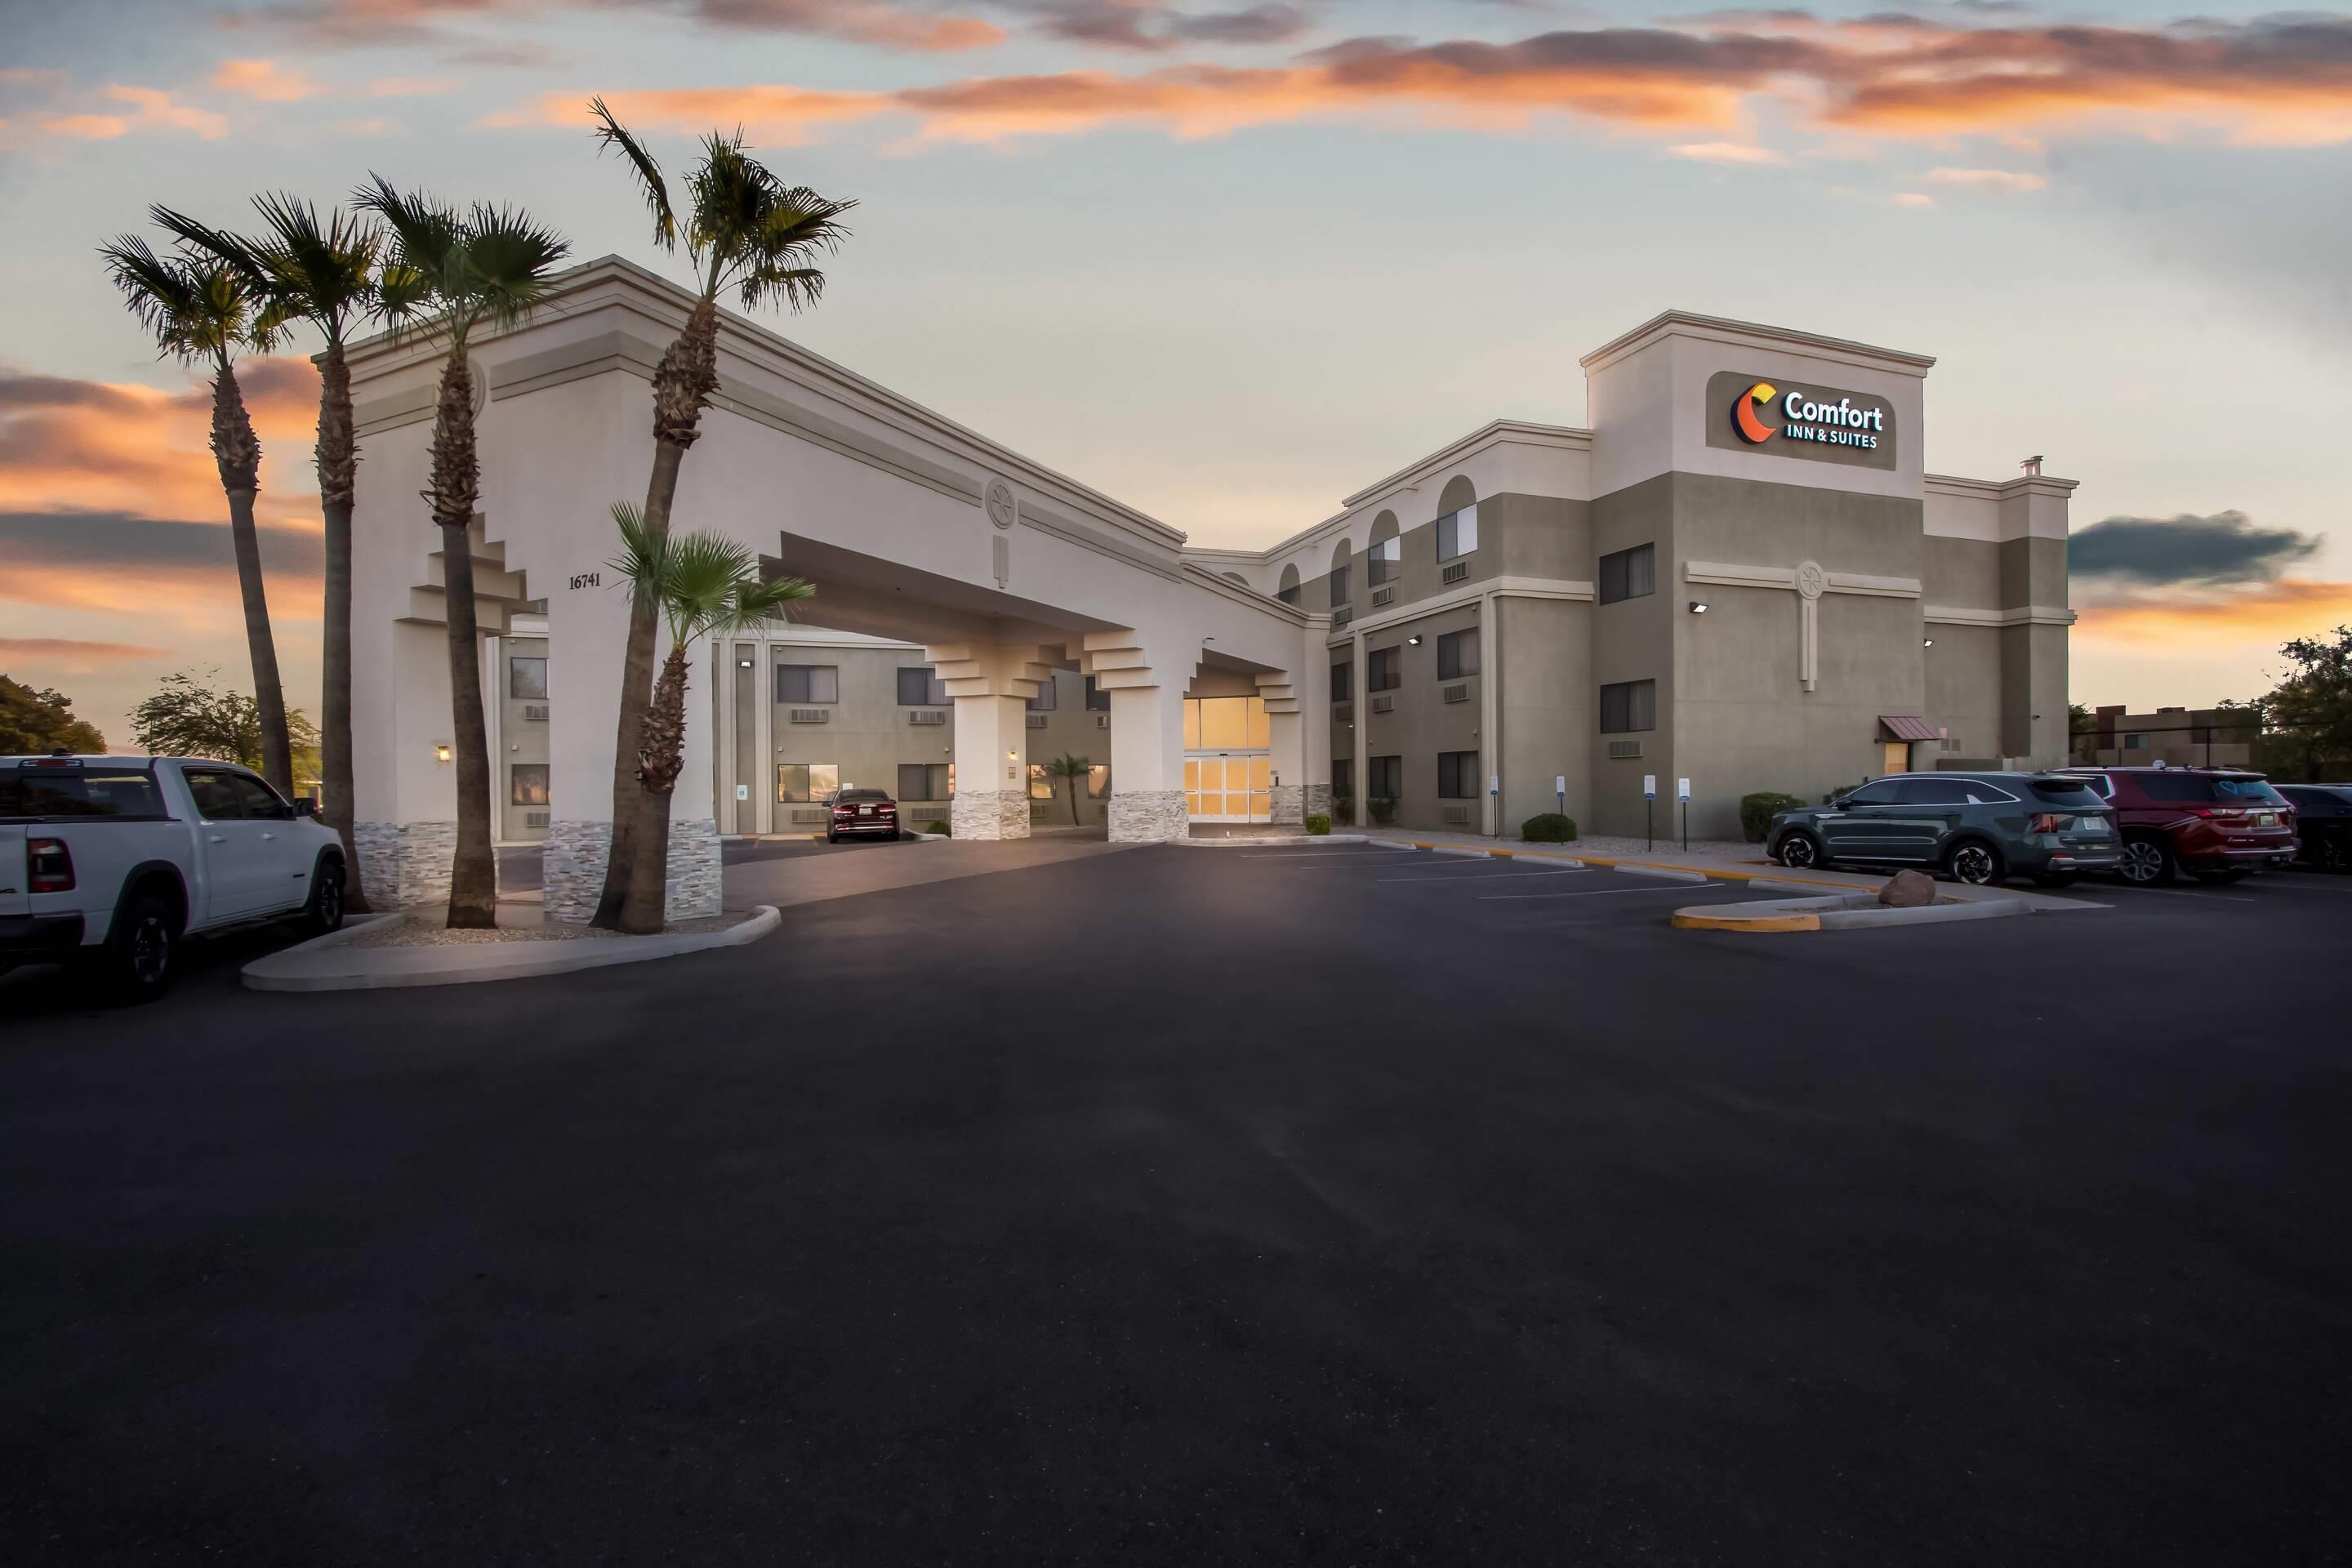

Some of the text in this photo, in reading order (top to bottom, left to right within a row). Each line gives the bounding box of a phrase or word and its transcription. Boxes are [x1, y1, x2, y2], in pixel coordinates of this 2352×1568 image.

[1784, 391, 1882, 431] Comfort
[1786, 424, 1878, 449] INN & SUITES
[569, 572, 601, 590] 16741
